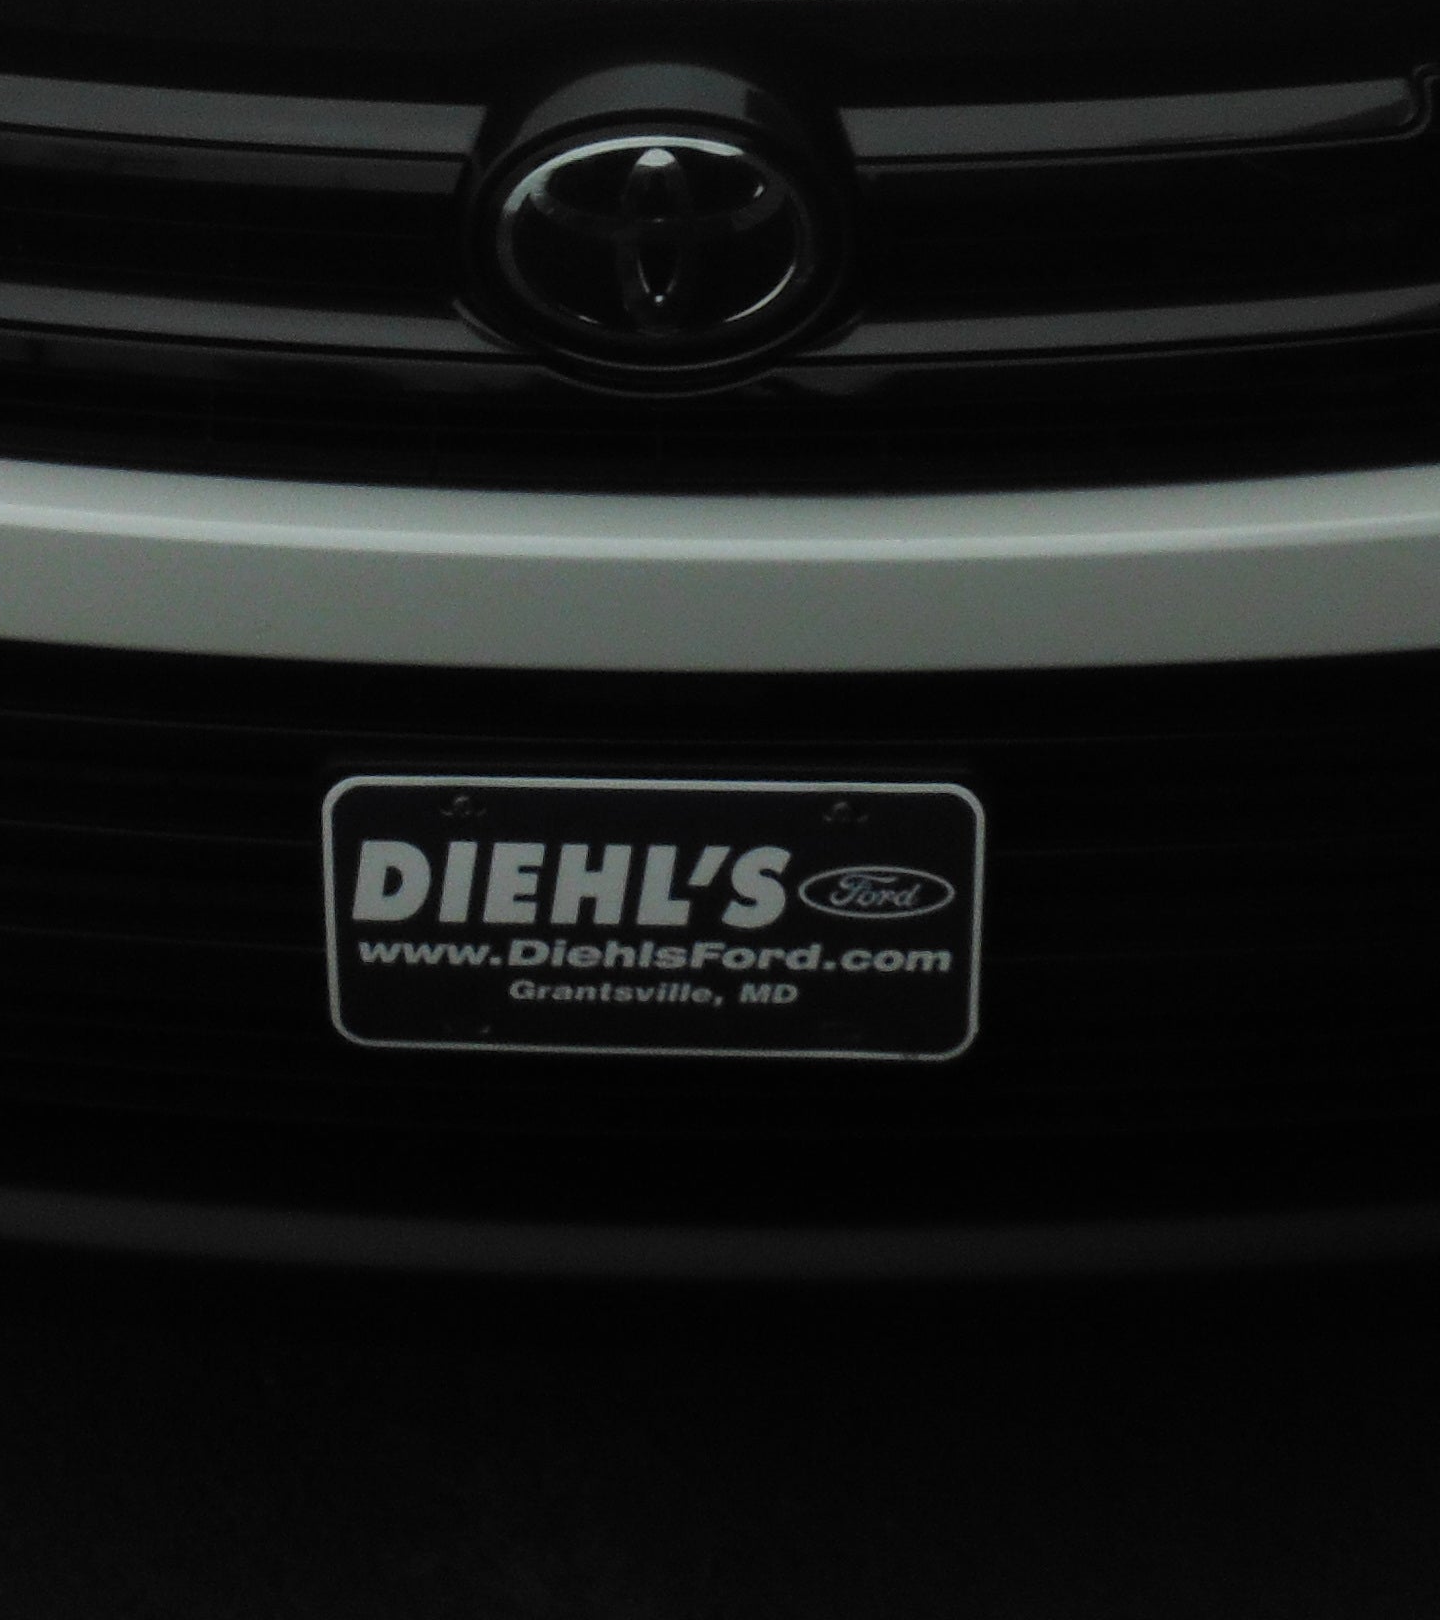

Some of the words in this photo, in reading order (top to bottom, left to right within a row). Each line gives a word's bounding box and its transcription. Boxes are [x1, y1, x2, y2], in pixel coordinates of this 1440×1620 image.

[352, 840, 791, 928] DIEHL'S
[830, 874, 921, 907] Ford
[358, 938, 952, 972] www.DiehlsFord.com
[509, 979, 724, 1007] Grantsville,
[739, 982, 799, 1005] MD
